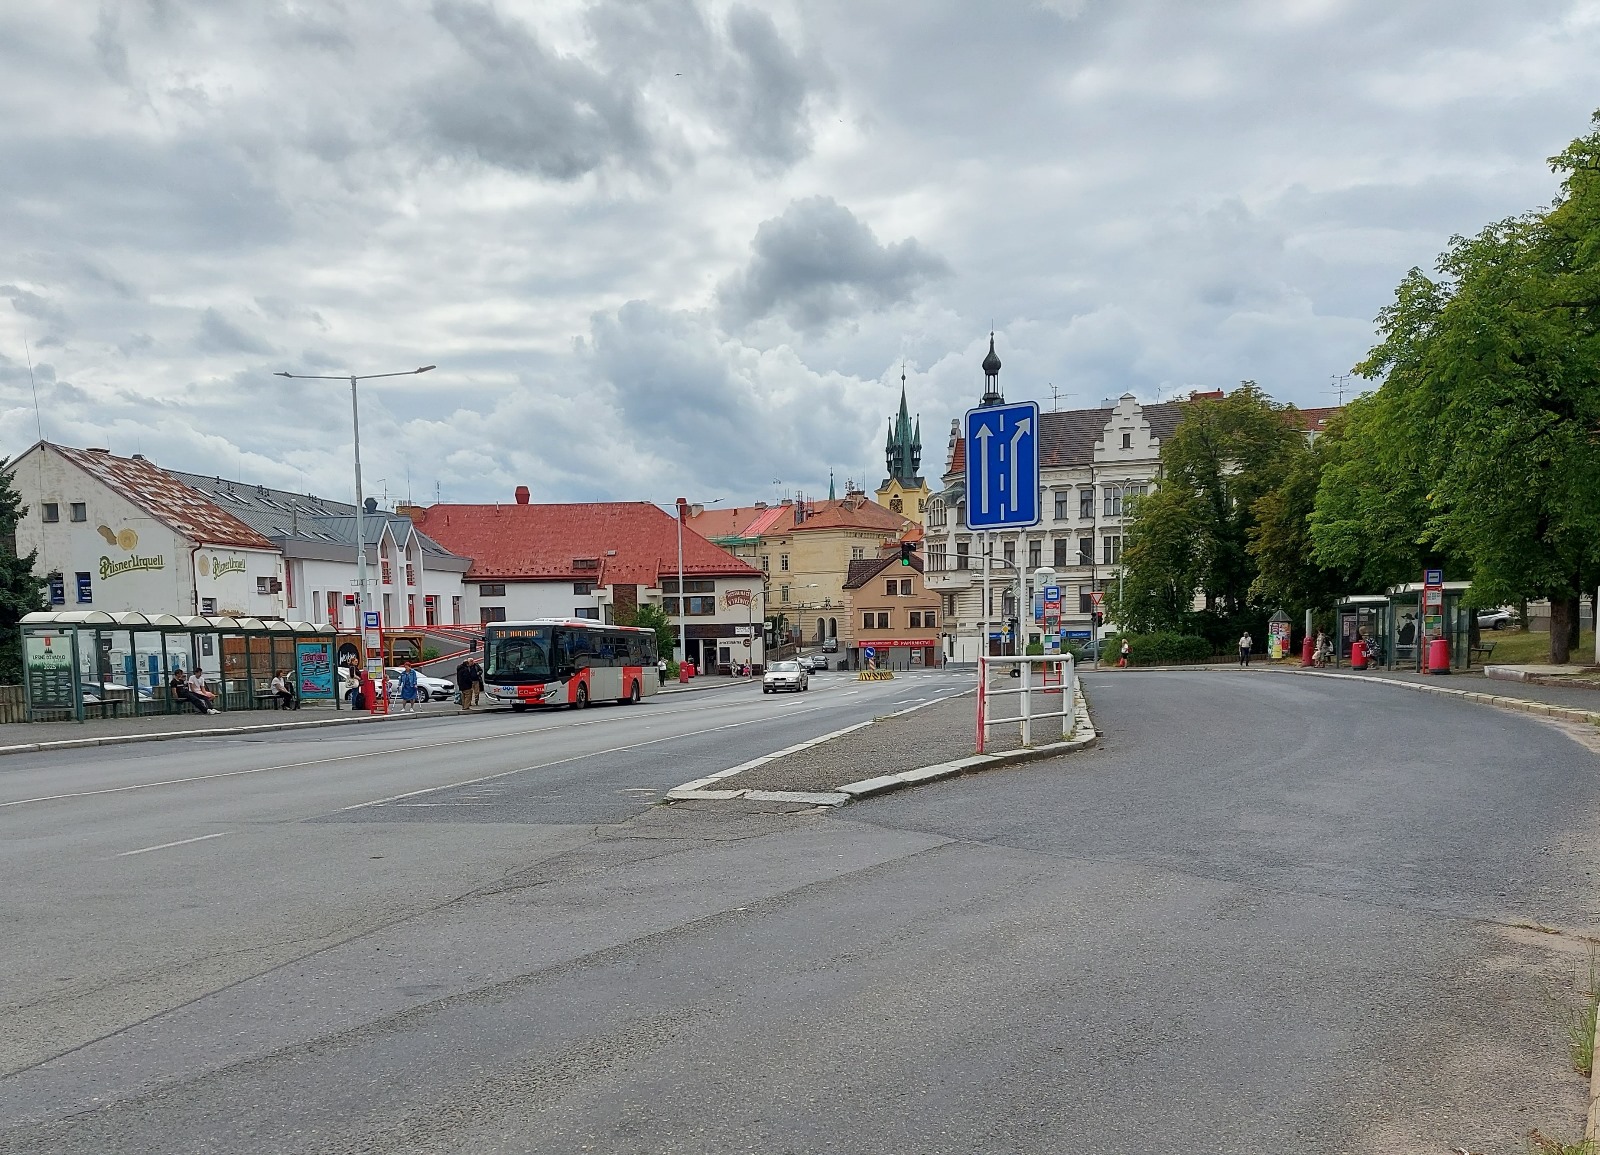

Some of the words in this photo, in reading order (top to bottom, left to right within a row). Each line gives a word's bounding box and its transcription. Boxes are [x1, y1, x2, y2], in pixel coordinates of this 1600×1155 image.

[100, 556, 132, 580] Pilsner
[131, 554, 164, 571] Urquell
[213, 557, 229, 580] Pilsner
[229, 556, 246, 573] Urquell
